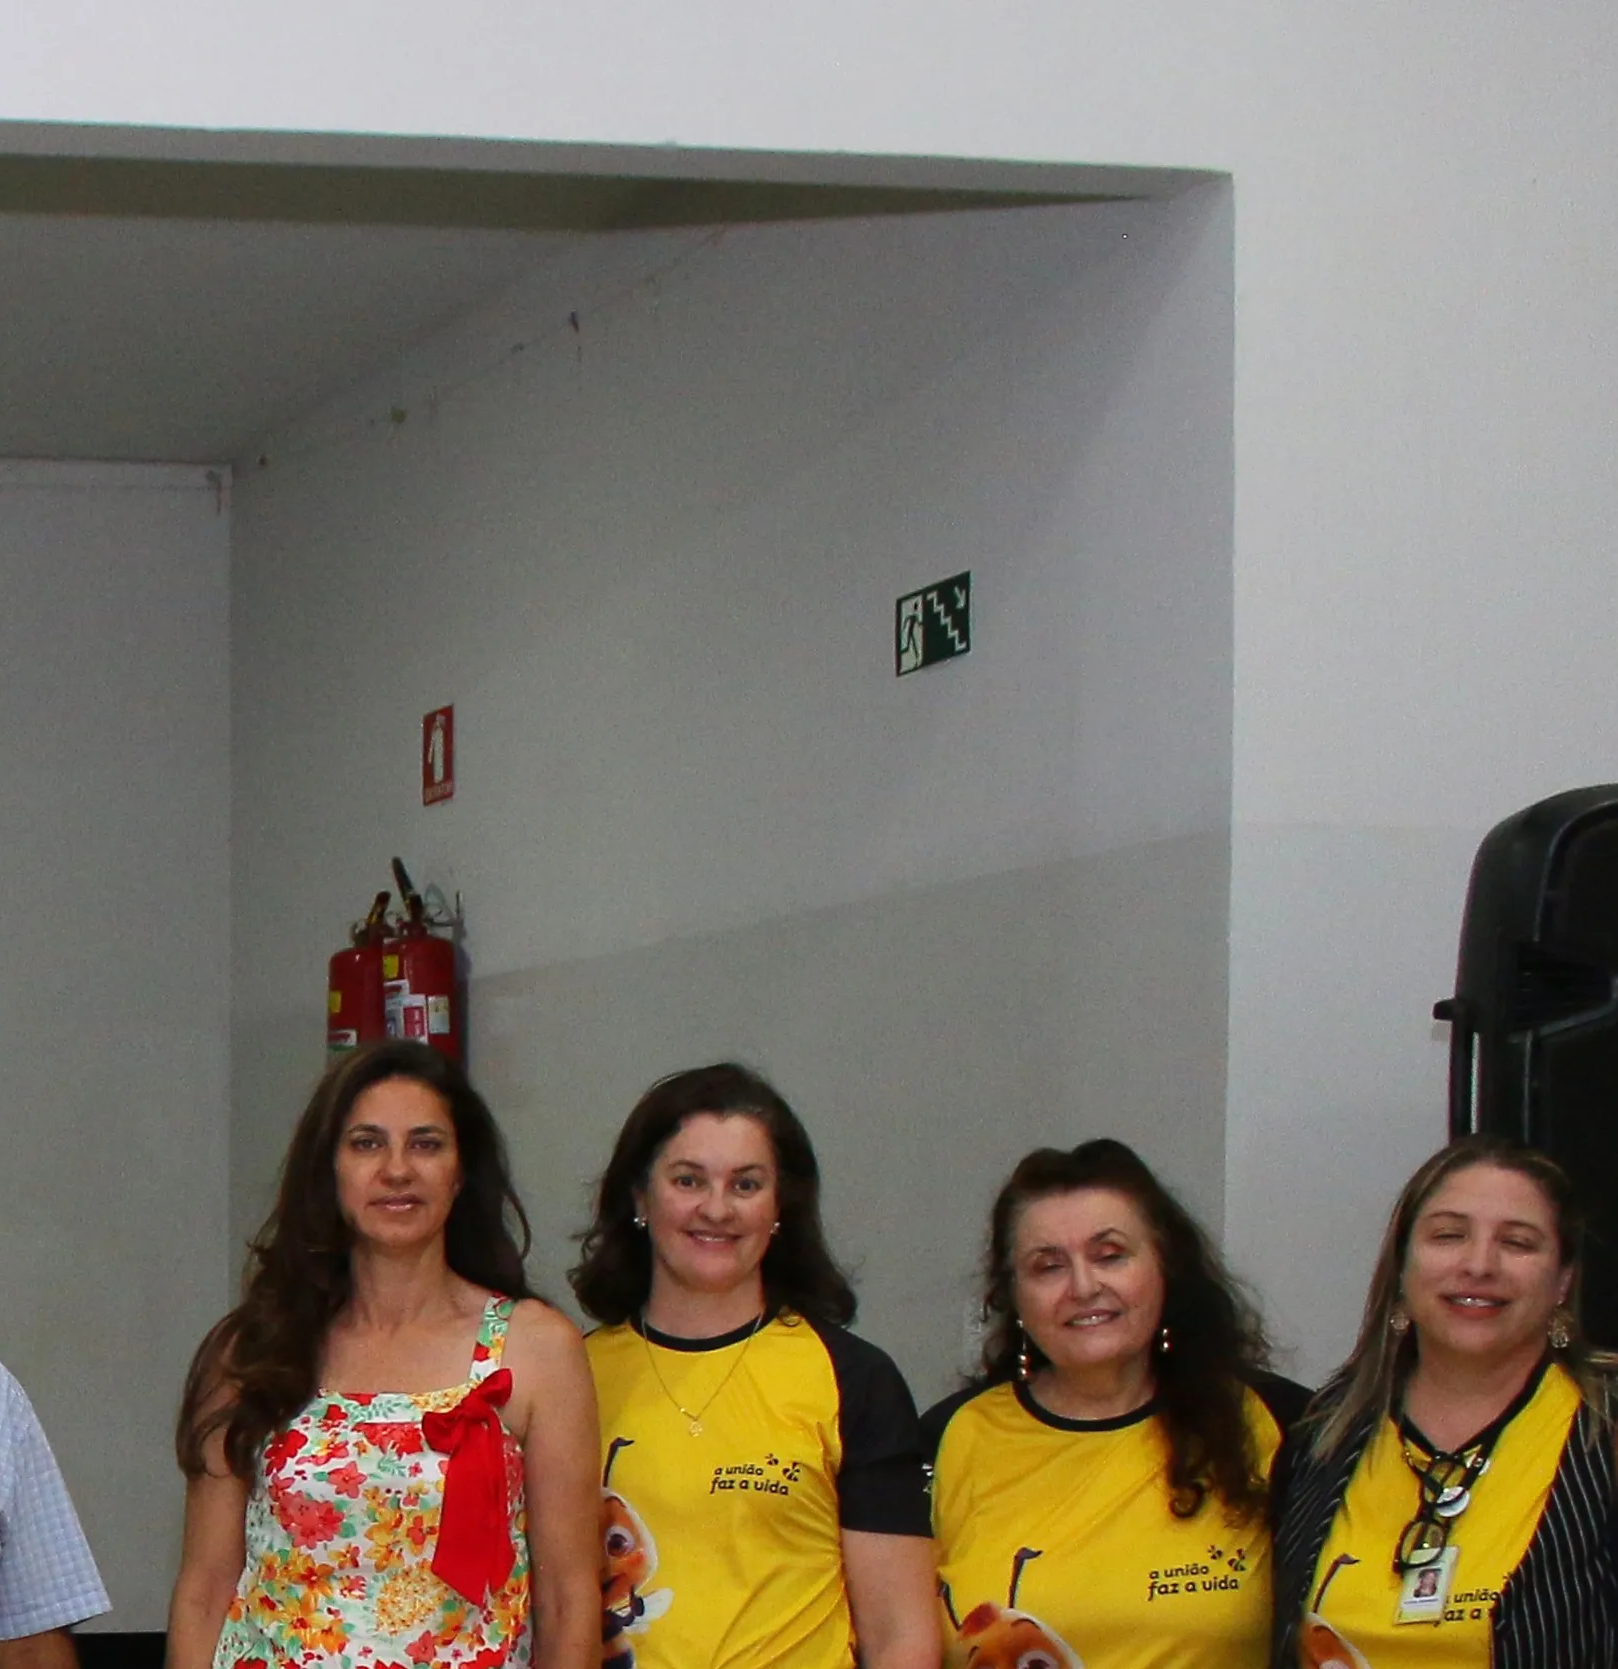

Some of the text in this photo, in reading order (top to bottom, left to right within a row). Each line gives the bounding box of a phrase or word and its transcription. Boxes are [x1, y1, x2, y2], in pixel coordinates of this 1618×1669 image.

[714, 1464, 764, 1476] a união
[709, 1477, 789, 1496] faz a vida
[1149, 1563, 1209, 1579] a união
[1147, 1575, 1239, 1601] faz a vida
[1454, 1588, 1500, 1603] união
[1470, 1608, 1482, 1620] a
